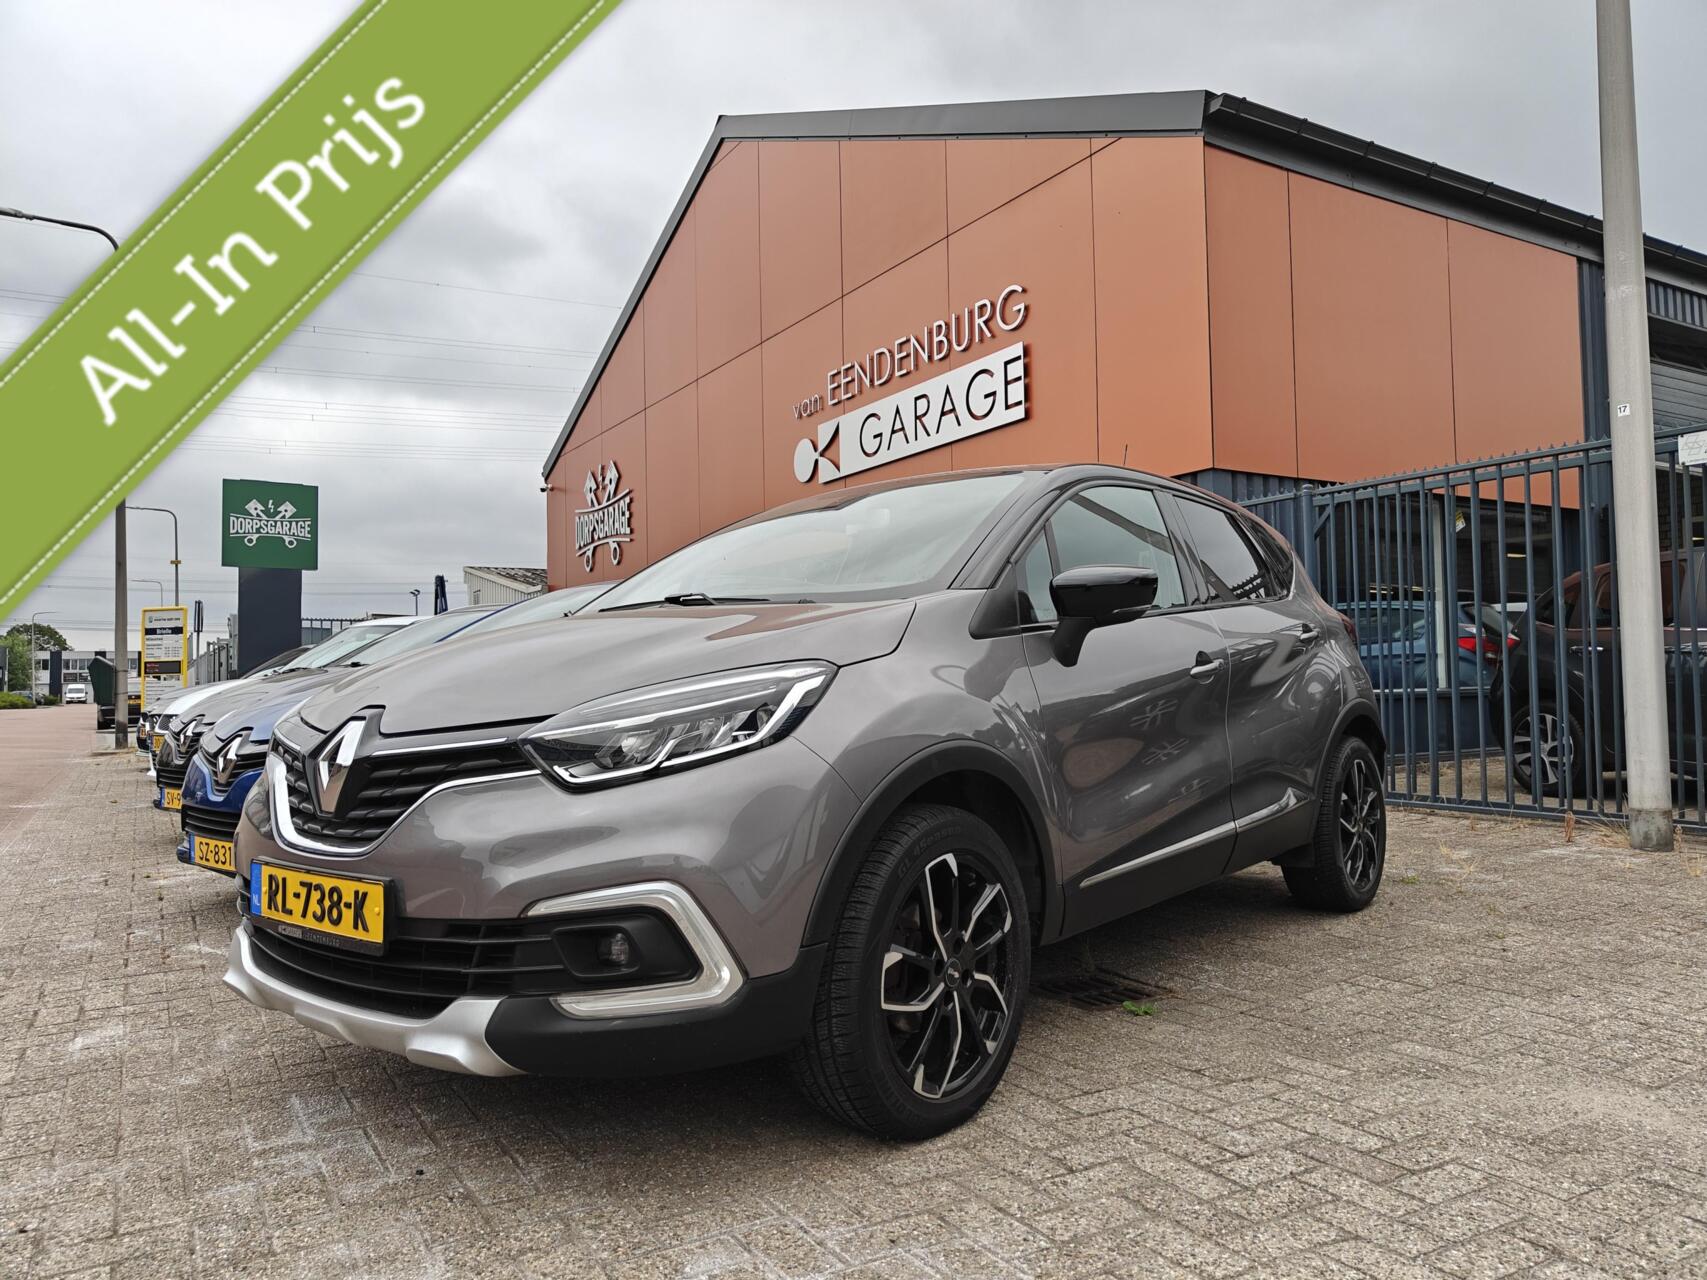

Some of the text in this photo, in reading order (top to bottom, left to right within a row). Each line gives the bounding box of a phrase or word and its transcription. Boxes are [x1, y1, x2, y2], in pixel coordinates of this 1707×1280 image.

[793, 284, 1027, 419] van EENDENBURG
[859, 354, 1023, 458] GARAGE
[1618, 405, 1627, 413] 17
[229, 516, 311, 537] DORPSGARAGE
[576, 496, 631, 550] DORPSGARAGE
[252, 873, 369, 933] NL RL-738-K
